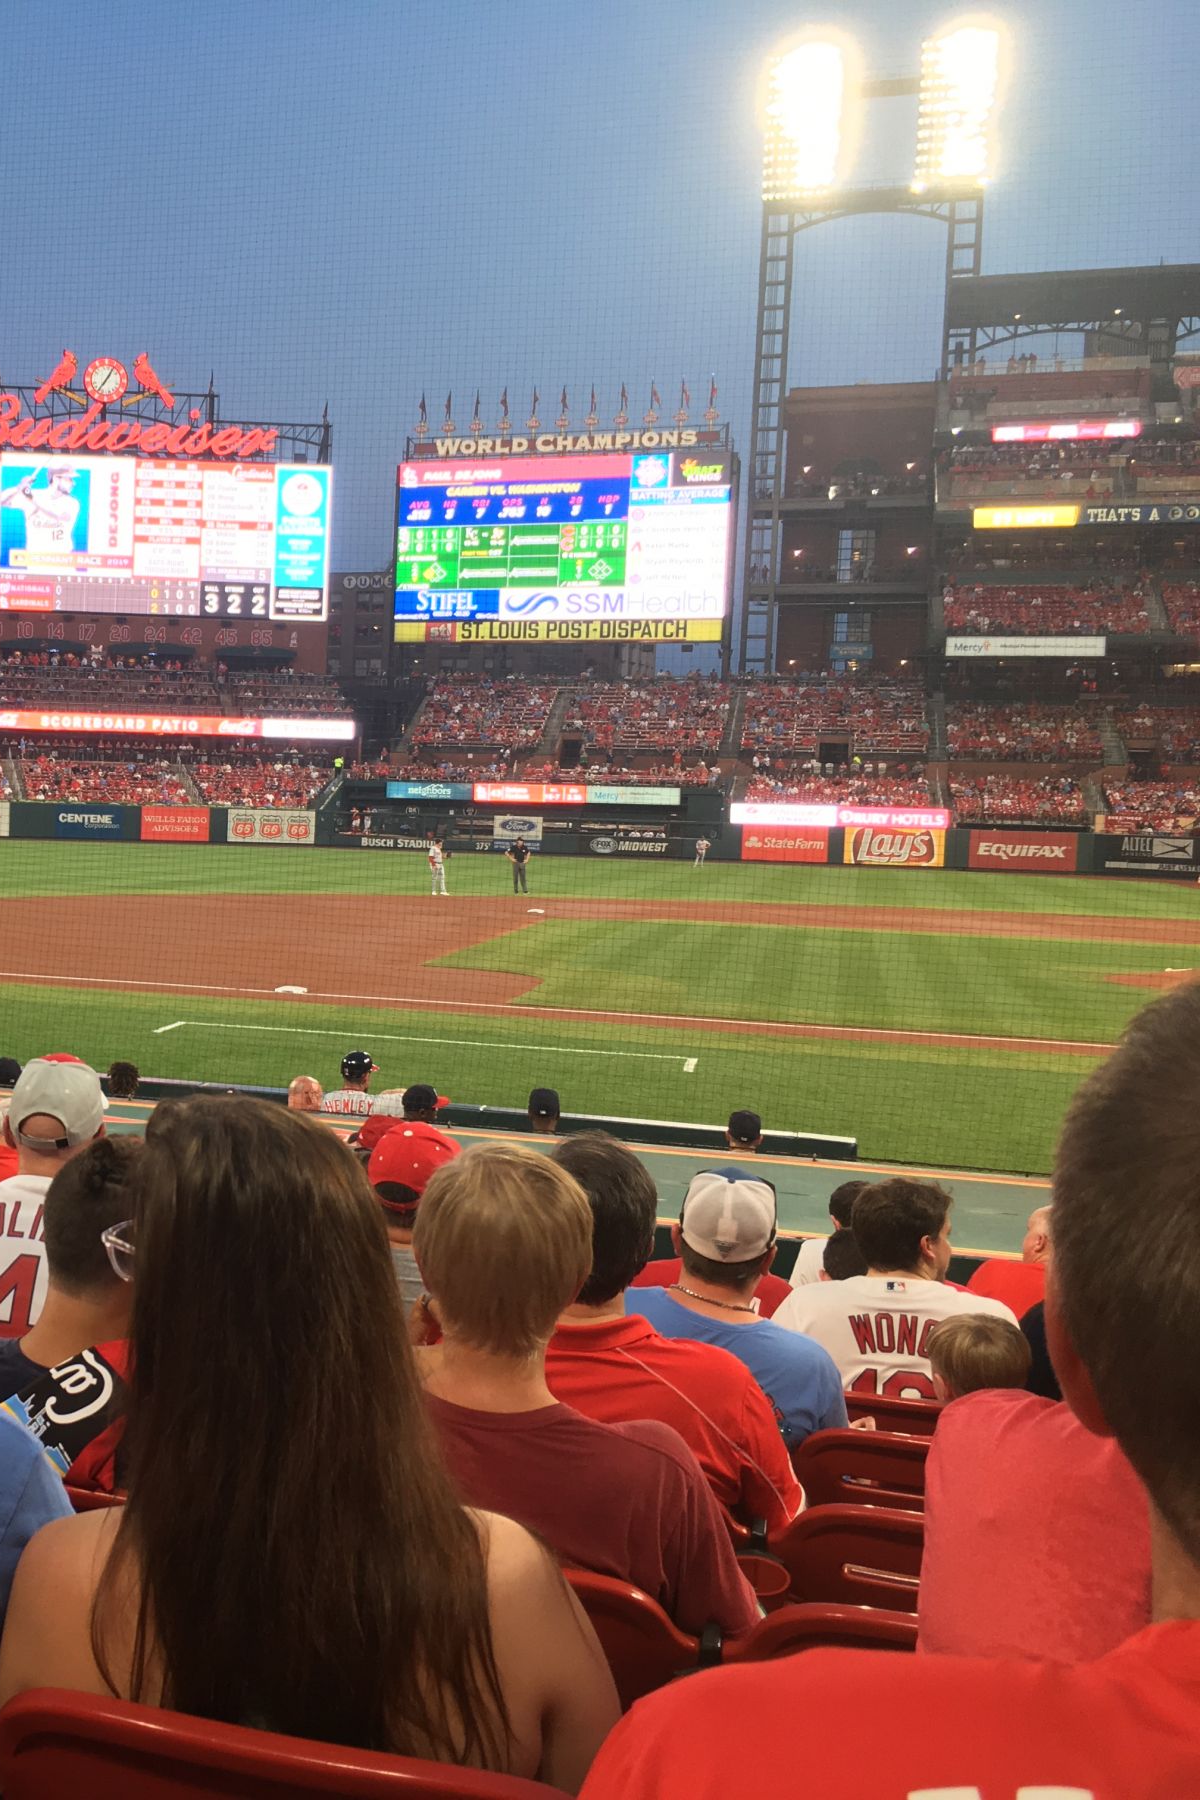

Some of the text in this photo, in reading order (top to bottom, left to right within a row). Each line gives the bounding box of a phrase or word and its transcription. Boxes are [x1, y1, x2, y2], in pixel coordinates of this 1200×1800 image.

[436, 430, 697, 456] WORLD CHAMPIONS
[678, 488, 724, 499] AVERAGE
[409, 501, 429, 509] AVG
[443, 500, 457, 508] HR
[472, 499, 490, 507] RBI
[502, 498, 523, 506] OPS
[540, 497, 548, 505] H
[598, 494, 620, 503] HBP
[108, 472, 119, 547] DEJONG
[1087, 507, 1160, 521] THAT'S A
[52, 530, 64, 541] 12
[77, 557, 102, 565] RACE
[258, 571, 266, 581] 5
[56, 586, 62, 595] 0
[151, 589, 158, 598] 0
[164, 589, 169, 599] 1
[176, 590, 183, 599] 0
[189, 591, 194, 599] 1
[204, 594, 219, 613] 3
[227, 595, 241, 614] 2
[252, 595, 266, 615] 2
[416, 590, 477, 611] STIFEL
[56, 600, 62, 610] 2
[150, 604, 158, 613] 2
[164, 604, 169, 613] 1
[176, 604, 183, 614] 0
[188, 605, 196, 614] 0
[17, 621, 33, 638] 10
[48, 622, 64, 640] 14
[78, 623, 96, 640] 17
[110, 625, 131, 642] 20
[144, 626, 166, 643] 24
[180, 627, 202, 645] 42
[215, 628, 238, 646] 45
[251, 630, 272, 646] 85
[461, 619, 687, 639] ST. LOUIS POST-DISPATCH
[954, 642, 982, 652] Mercy
[40, 714, 146, 731] SCOREBOARD
[152, 719, 198, 732] PATIO
[408, 786, 451, 796] neighbors
[594, 791, 618, 801] Mercy
[58, 812, 113, 825] CENTENE
[144, 815, 208, 824] WELLS FARGO
[840, 809, 945, 827] DRURY HOTELS
[84, 822, 120, 830] Corporation
[152, 825, 199, 833] ADVISORS
[236, 825, 251, 834] 66
[263, 825, 278, 834] 66
[291, 826, 306, 835] 66
[506, 820, 531, 831] Ford
[361, 837, 443, 849] BUSCH STADIU
[596, 840, 668, 852] FOX MIDWEST
[1121, 837, 1152, 852] ALTEC
[977, 843, 1065, 859] EQUIFAX
[325, 1099, 373, 1116] HENLEY
